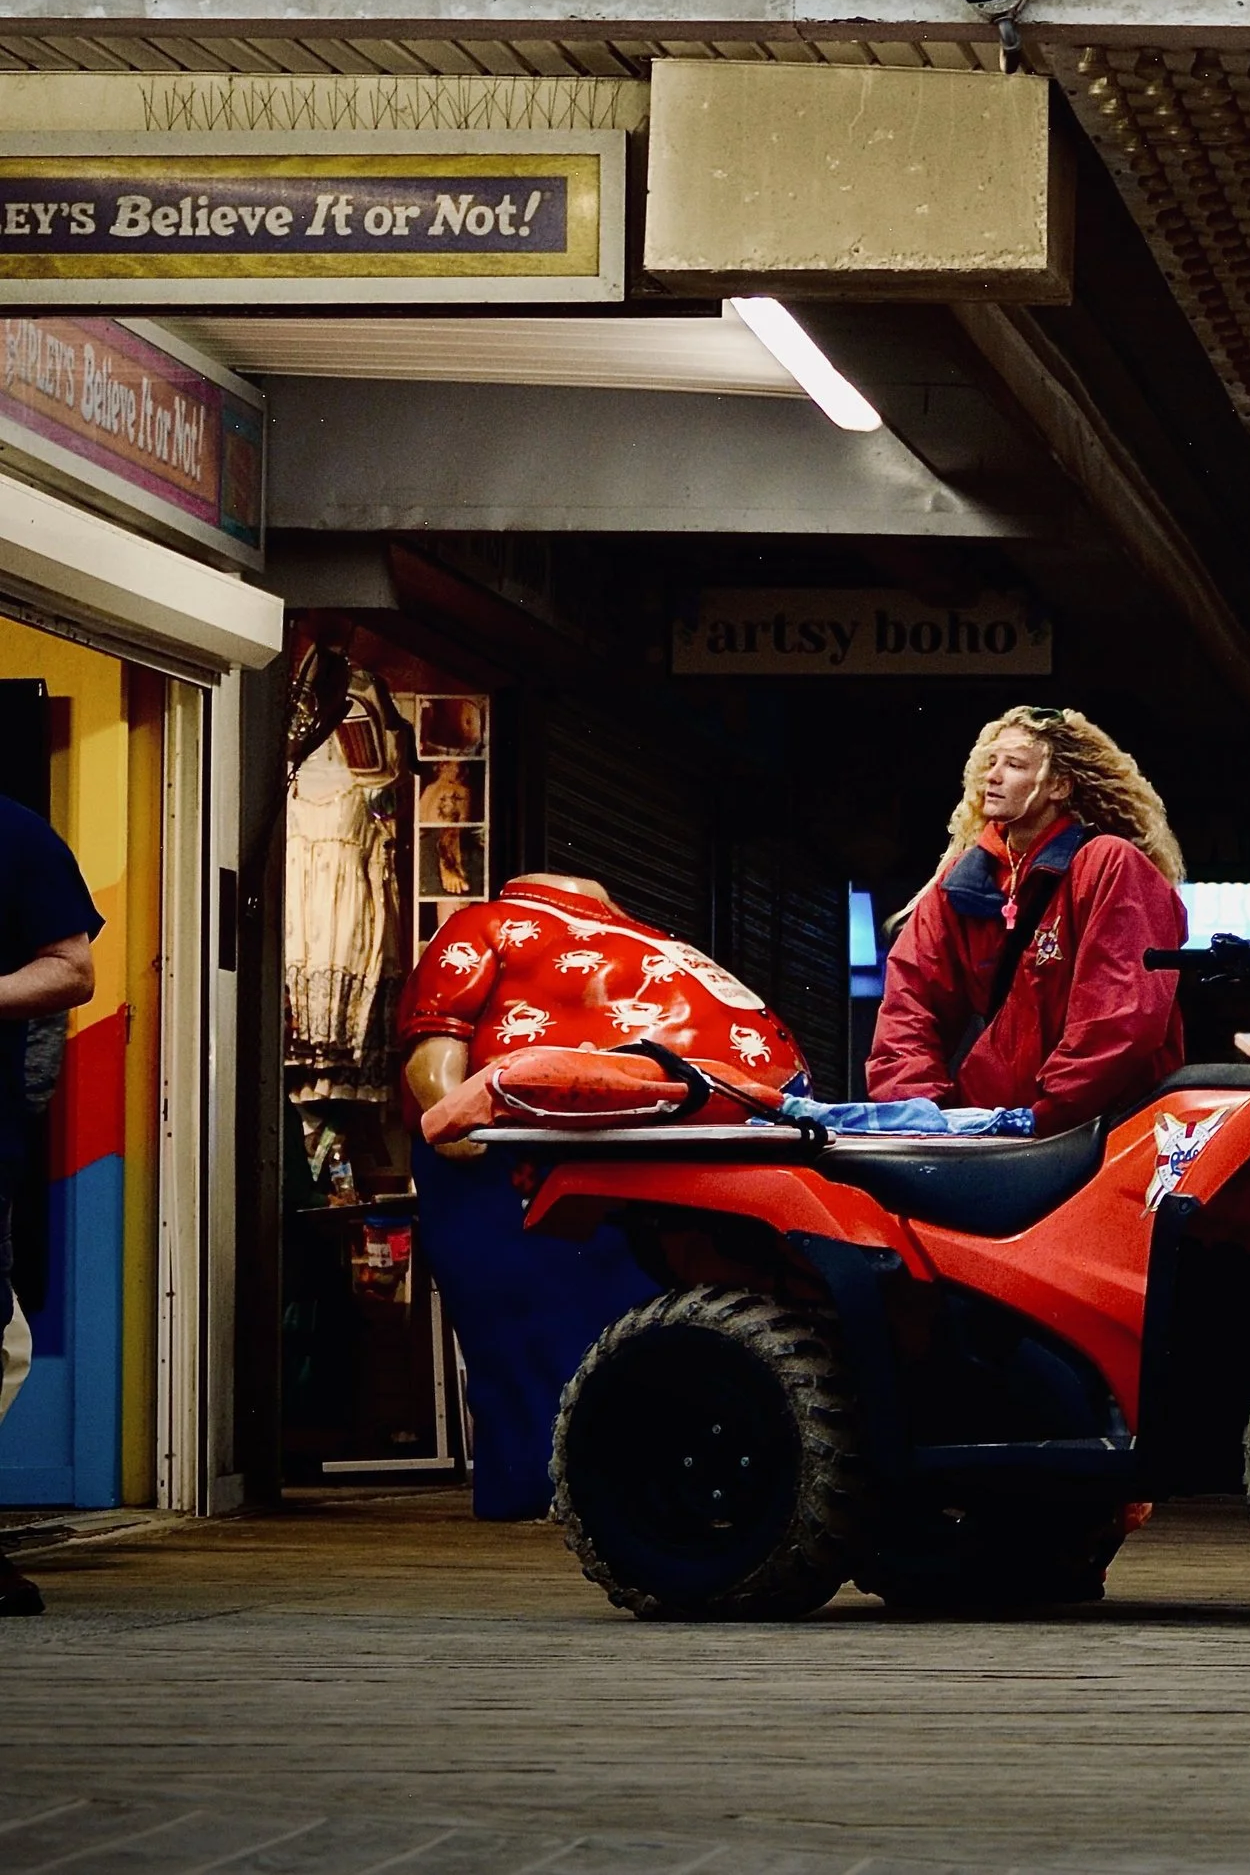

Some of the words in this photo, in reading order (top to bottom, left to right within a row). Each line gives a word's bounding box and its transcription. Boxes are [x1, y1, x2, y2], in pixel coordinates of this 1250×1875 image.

[109, 194, 294, 238] Believe
[305, 194, 354, 237] It
[363, 205, 421, 237] or
[427, 190, 542, 238] Not!
[80, 342, 137, 445] Believe
[138, 376, 154, 454] It
[155, 405, 172, 468] or
[171, 395, 206, 483] Not!
[705, 611, 859, 665] artsy
[874, 608, 1019, 656] boho
